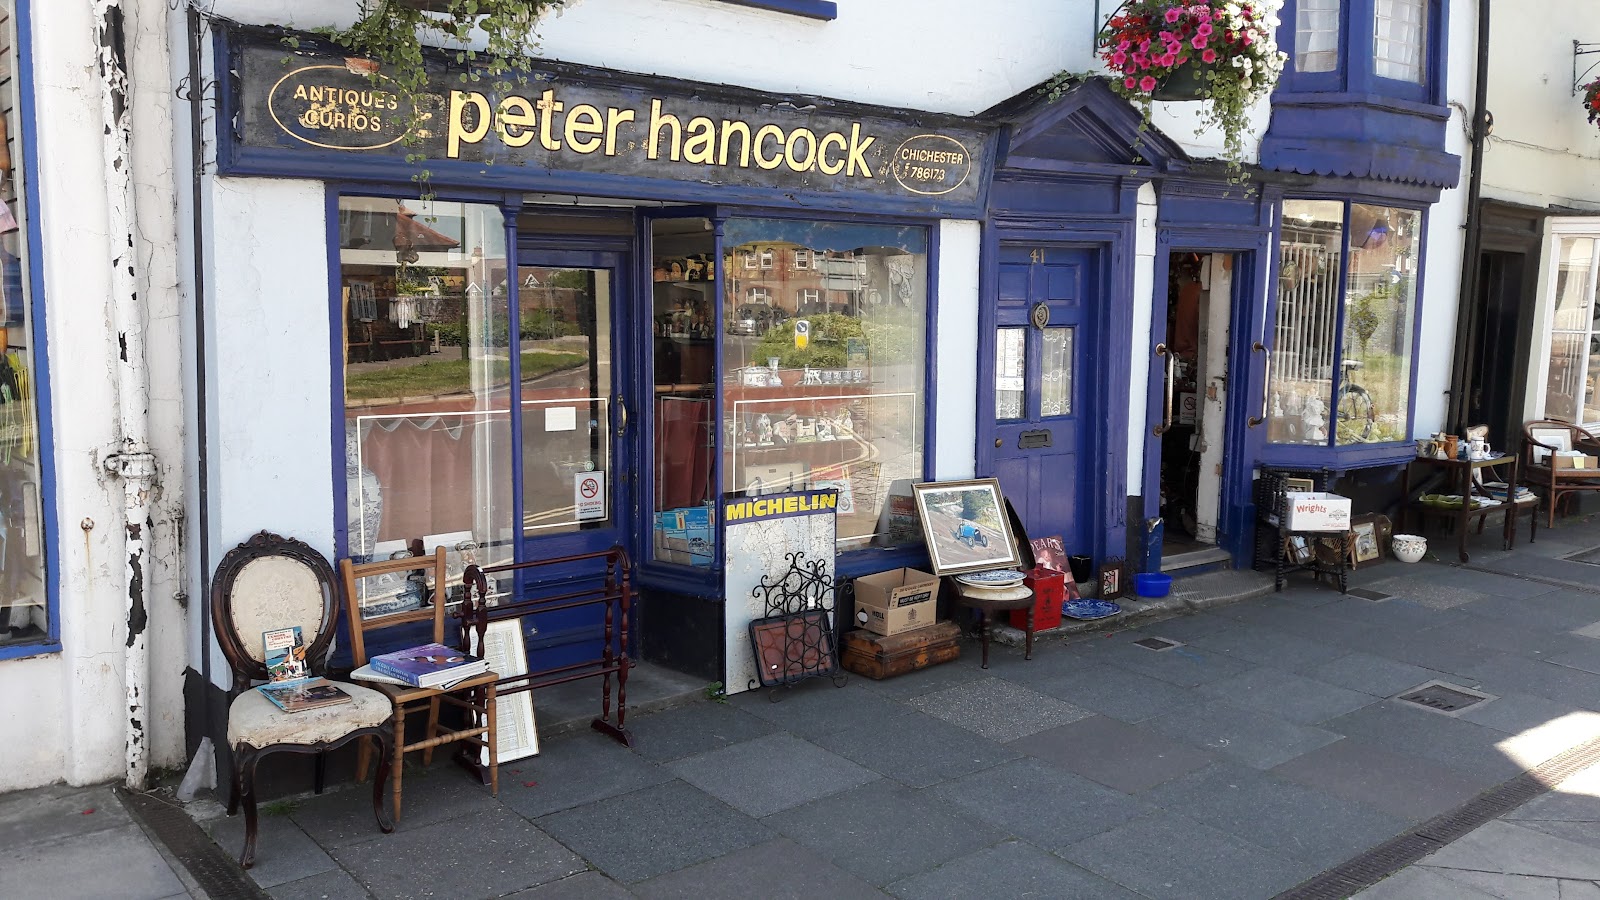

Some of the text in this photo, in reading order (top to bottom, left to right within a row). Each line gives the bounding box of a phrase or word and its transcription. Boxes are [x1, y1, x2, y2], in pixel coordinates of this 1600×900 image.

[293, 84, 398, 110] ANTIQUES
[304, 109, 381, 132] CURIOS
[446, 88, 876, 178] peter hancock
[901, 148, 964, 165] CHICHESTER
[910, 166, 946, 181] 786173
[1029, 248, 1045, 264] 41
[726, 493, 837, 521] MICHELIN
[1296, 503, 1327, 514] Wrights
